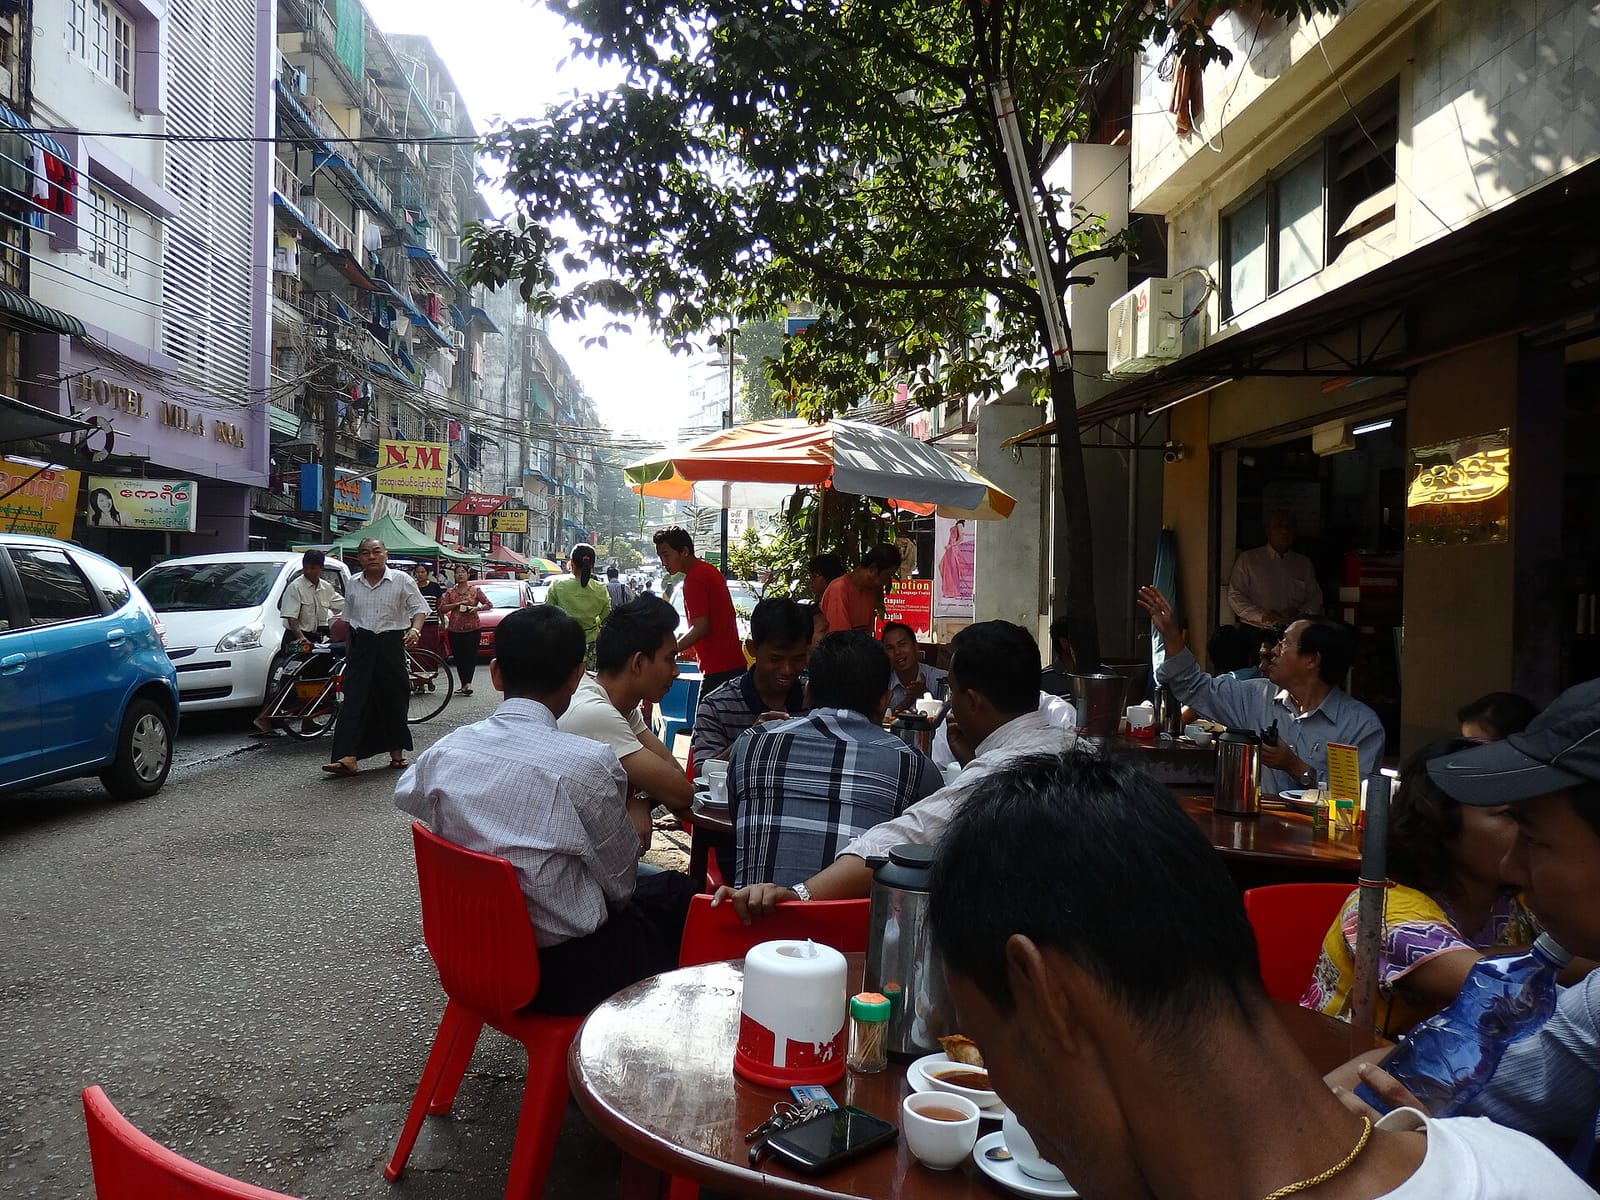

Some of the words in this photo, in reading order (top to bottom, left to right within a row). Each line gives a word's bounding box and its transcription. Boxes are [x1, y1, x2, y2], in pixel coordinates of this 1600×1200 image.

[77, 374, 149, 419] HOTEL
[891, 580, 929, 590] motion
[883, 597, 905, 605] Computer
